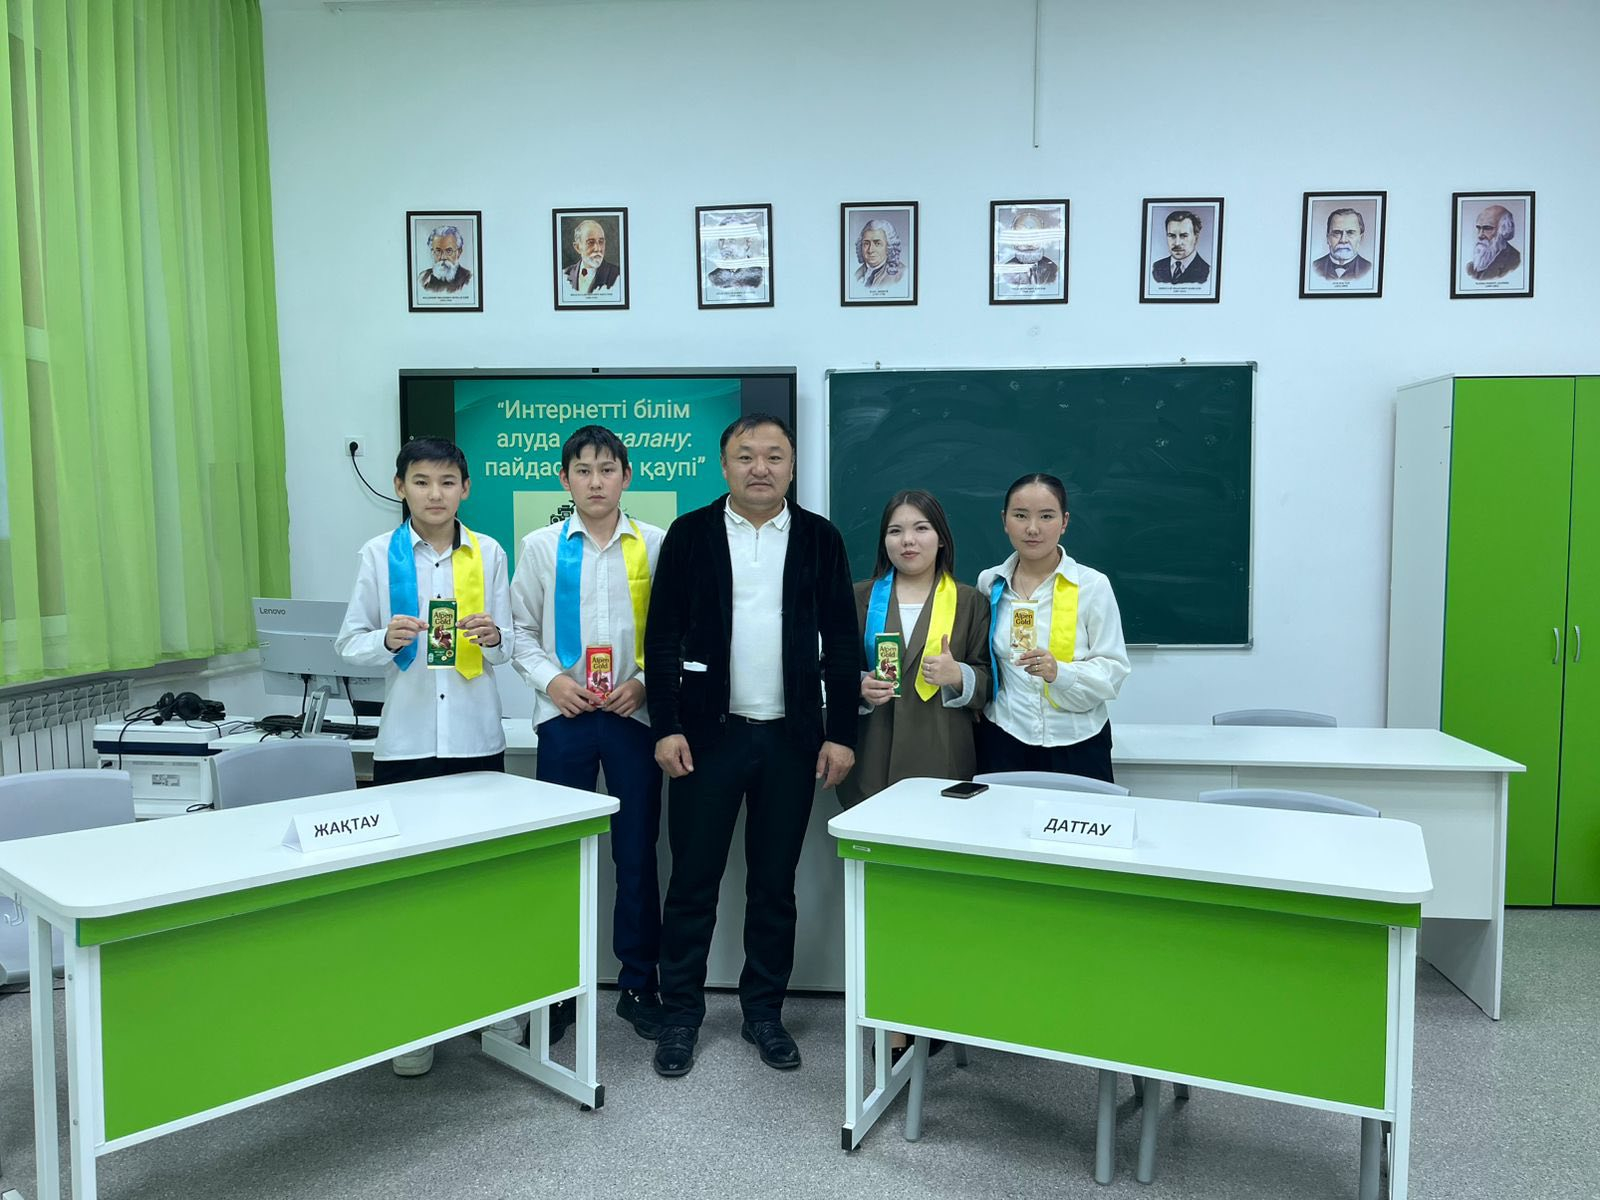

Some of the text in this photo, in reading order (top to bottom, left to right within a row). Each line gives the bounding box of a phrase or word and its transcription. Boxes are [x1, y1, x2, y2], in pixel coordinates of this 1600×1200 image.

[497, 399, 691, 423] “Интернетті білім
[496, 432, 561, 453] алуда
[640, 456, 706, 481] қаупі”
[259, 606, 286, 616] Lenovo
[434, 612, 453, 620] Alpen
[1015, 612, 1033, 621] Alpen
[592, 656, 610, 664] Alpen
[313, 813, 380, 838] ЖАҚТАУ
[1043, 817, 1112, 837] ДАТТАУ
